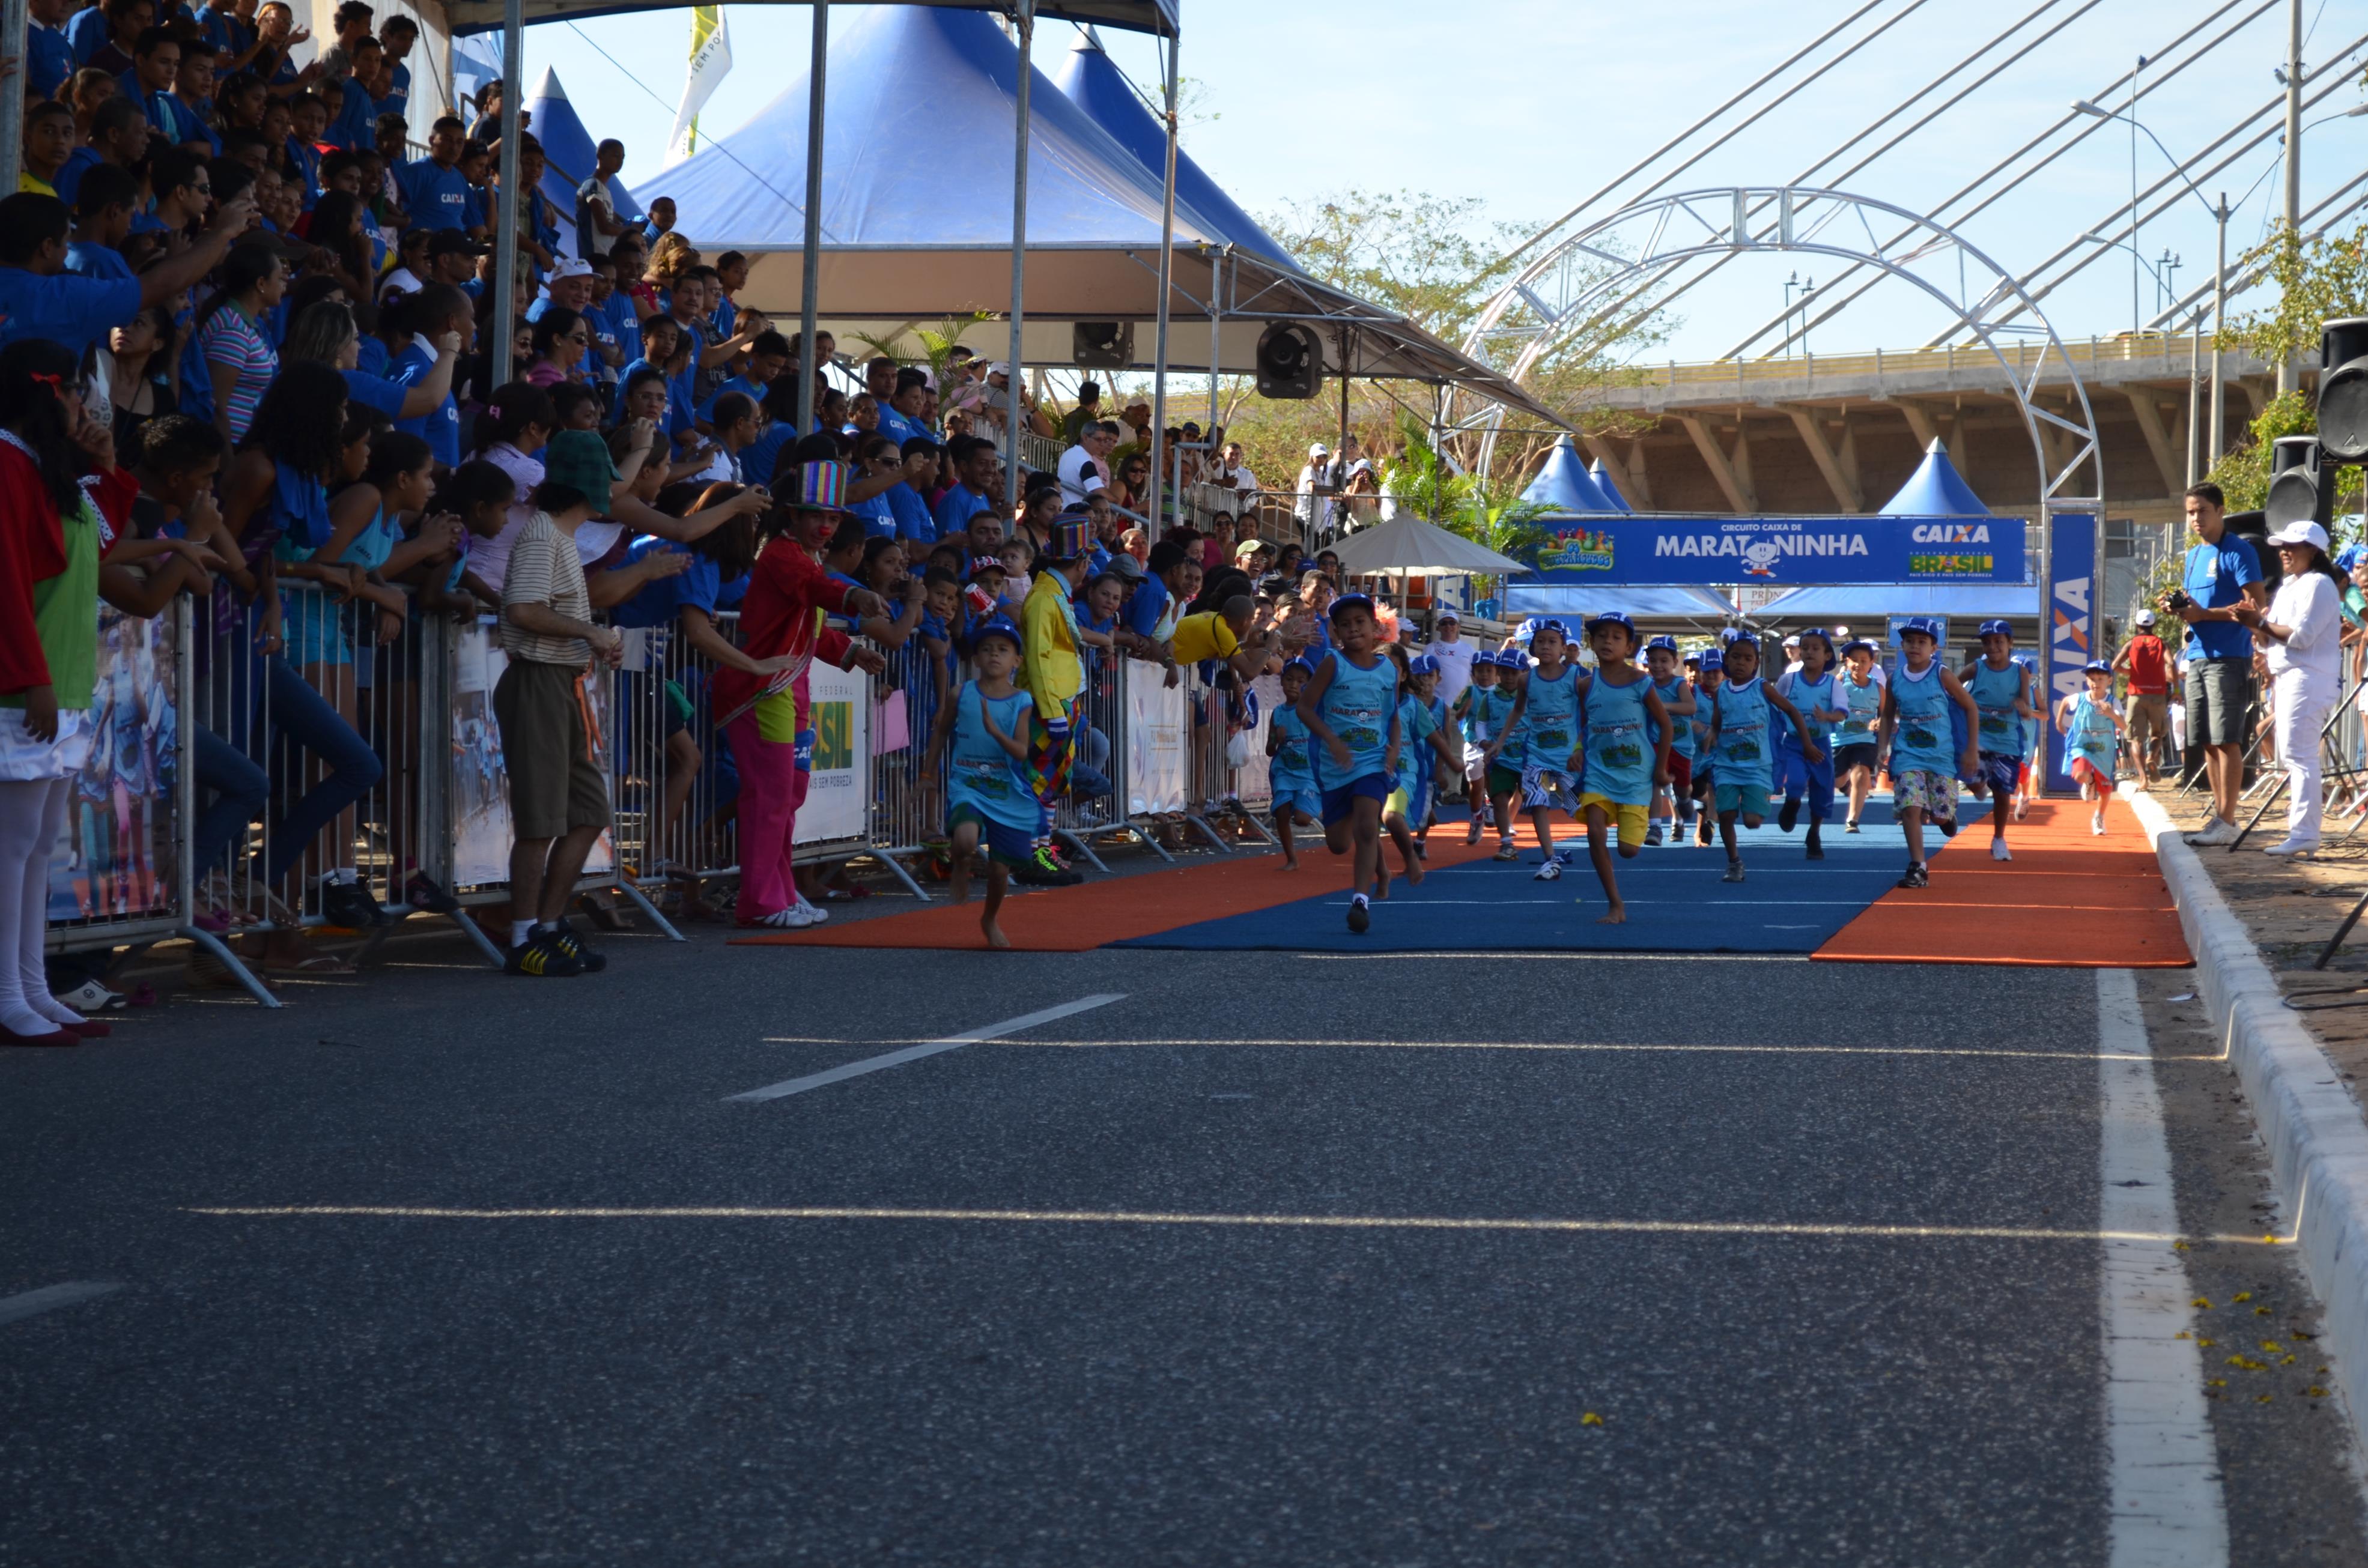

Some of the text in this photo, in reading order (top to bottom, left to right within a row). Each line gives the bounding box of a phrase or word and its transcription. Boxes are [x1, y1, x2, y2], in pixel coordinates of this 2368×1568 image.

[441, 193, 465, 203] CAIXA
[1912, 525, 1990, 543] CAIXA
[1654, 534, 1869, 557] MARATNINHA
[1910, 555, 1993, 572] BRASIL
[820, 685, 853, 695] FEDERAL
